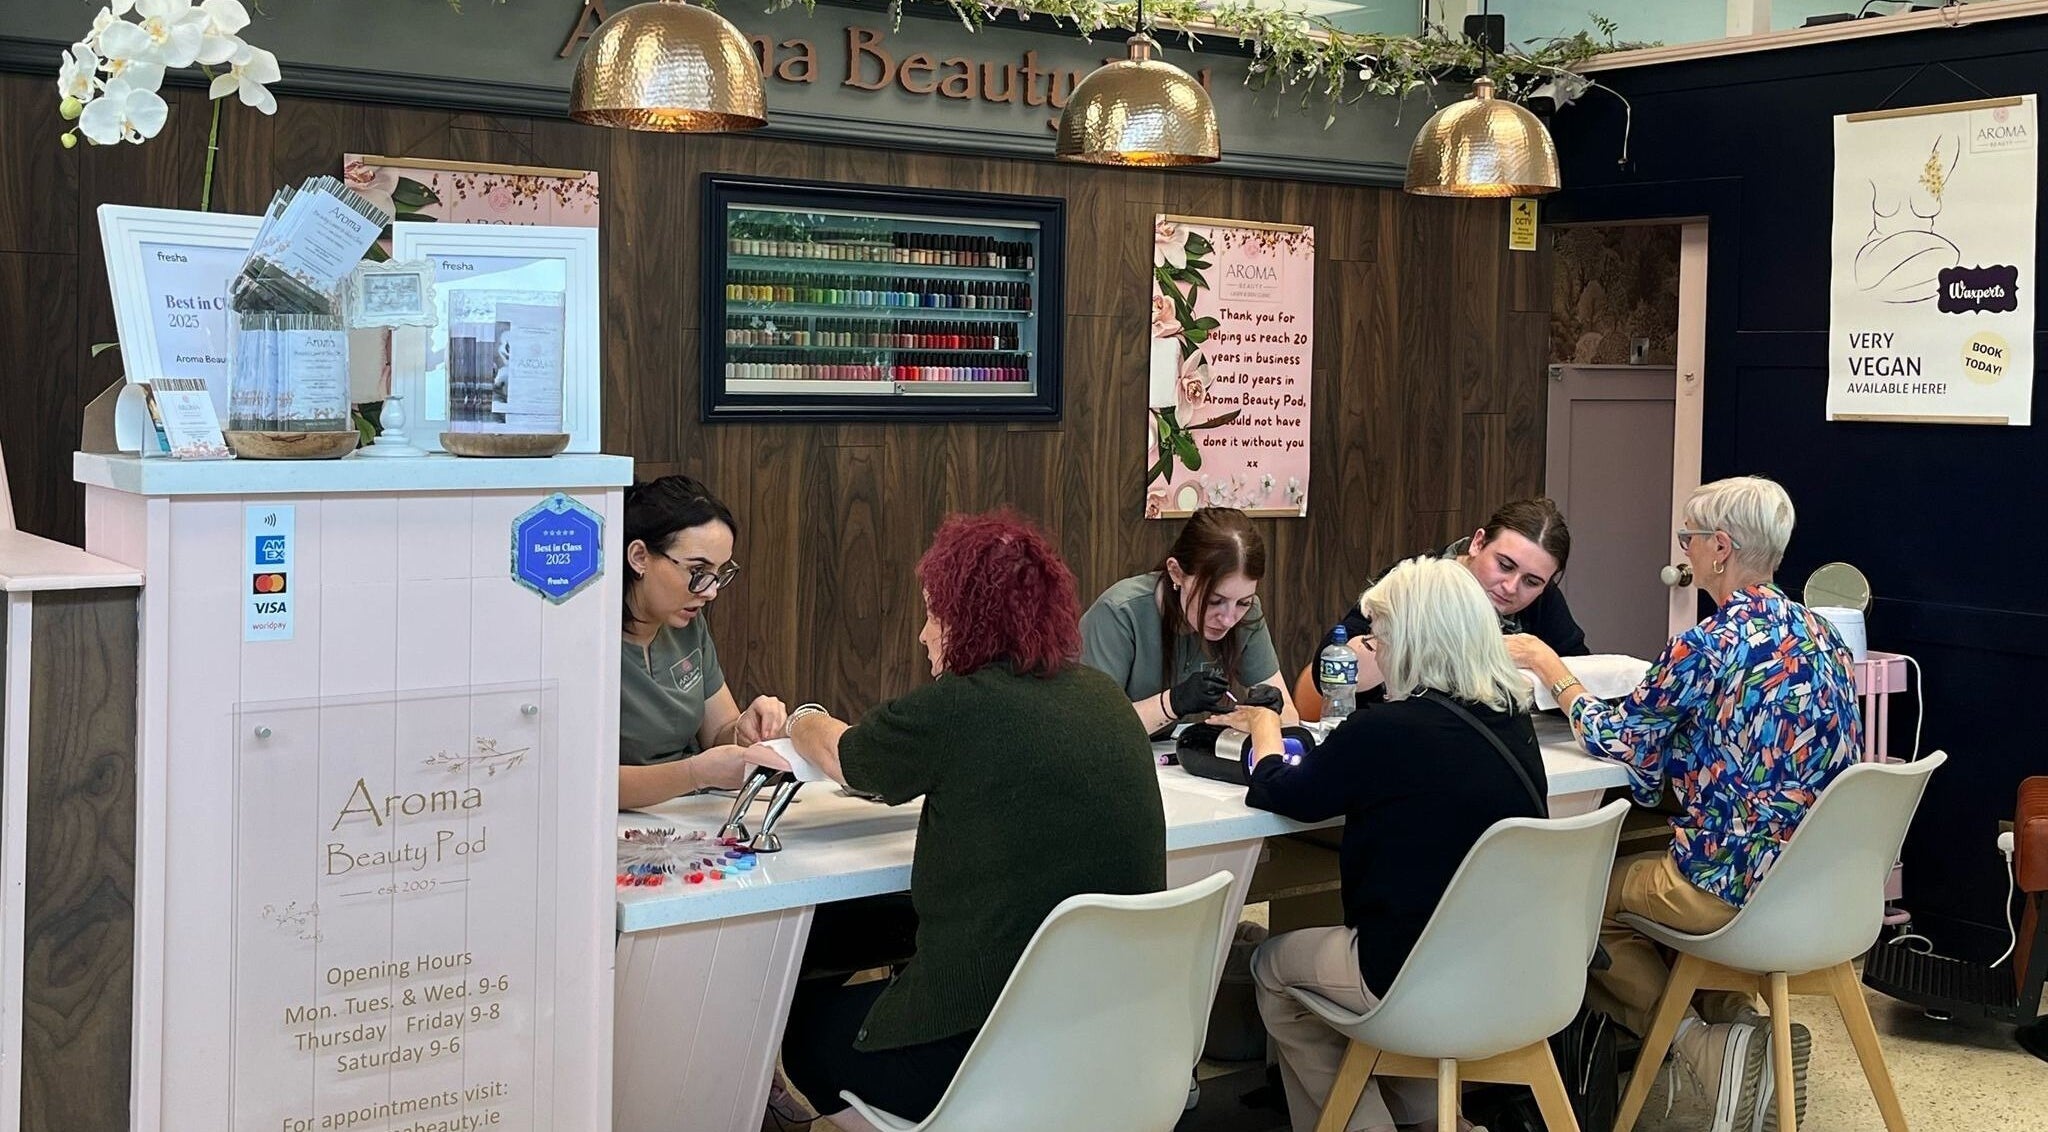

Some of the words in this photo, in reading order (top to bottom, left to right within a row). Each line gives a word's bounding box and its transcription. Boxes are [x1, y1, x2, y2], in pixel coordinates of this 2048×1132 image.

[842, 25, 1082, 132] Beauty
[1977, 125, 2027, 141] AROMA
[328, 206, 361, 232] Aroma
[1515, 217, 1532, 226] CCTV
[157, 251, 188, 263] fresha
[442, 261, 474, 271] fresha
[1226, 264, 1277, 281] AROMA
[1949, 280, 2005, 304] Waxperts
[165, 295, 195, 309] Best
[199, 297, 211, 310] in
[168, 314, 200, 328] 2025
[1220, 308, 1253, 321] Thank
[1256, 314, 1275, 326] you
[1278, 312, 1295, 323] for
[1245, 334, 1257, 342] us
[1260, 332, 1290, 343] reach
[1293, 333, 1307, 345] 20
[1849, 333, 1894, 349] VERY
[1972, 342, 2004, 359] BOOK
[176, 355, 203, 364] Aroma
[205, 356, 226, 364] Beau
[1212, 353, 1240, 366] years
[1244, 353, 1252, 363] in
[1256, 352, 1300, 365] business
[1848, 356, 1921, 376] VEGAN
[1965, 357, 2002, 376] TODAY!
[1216, 372, 1235, 384] and
[1238, 374, 1249, 384] 10
[1252, 376, 1282, 388] years
[1285, 375, 1295, 385] in
[1847, 383, 1909, 394] AVAILABLE
[1912, 383, 1947, 394] HERE!
[1203, 392, 1239, 404] Aroma
[1243, 392, 1279, 410] Beauty
[1284, 394, 1307, 408] Pod,
[1254, 417, 1272, 427] not
[1276, 415, 1301, 427] have
[1203, 434, 1227, 447] done
[1230, 437, 1238, 447] it
[1242, 435, 1282, 448] without
[1286, 440, 1304, 452] you
[1247, 460, 1258, 468] xx
[534, 544, 551, 553] Best
[553, 544, 560, 552] in
[562, 543, 582, 552] Class
[546, 553, 570, 565] 2023
[547, 577, 569, 585] fresha
[255, 602, 287, 614] VISA
[252, 622, 287, 631] worldpay
[331, 777, 482, 831] Aroma
[326, 843, 428, 875] Beauty
[437, 826, 486, 862] Pod
[377, 882, 398, 895] est
[402, 878, 437, 892] 2005
[327, 960, 410, 987] Opening
[417, 952, 472, 972] Hours
[285, 1006, 337, 1025] Mon.
[345, 997, 394, 1014] Tues.
[402, 989, 417, 1006] &
[424, 980, 472, 1003] Wed.
[479, 974, 509, 994] 9-6
[294, 1023, 387, 1051] Thursday
[407, 1011, 465, 1034] Friday
[471, 1003, 500, 1023] 9-8
[337, 1045, 424, 1072] Saturday
[430, 1037, 460, 1057] 9-6
[283, 1118, 315, 1132] For
[322, 1090, 458, 1130] appointments
[465, 1081, 509, 1102] visit:
